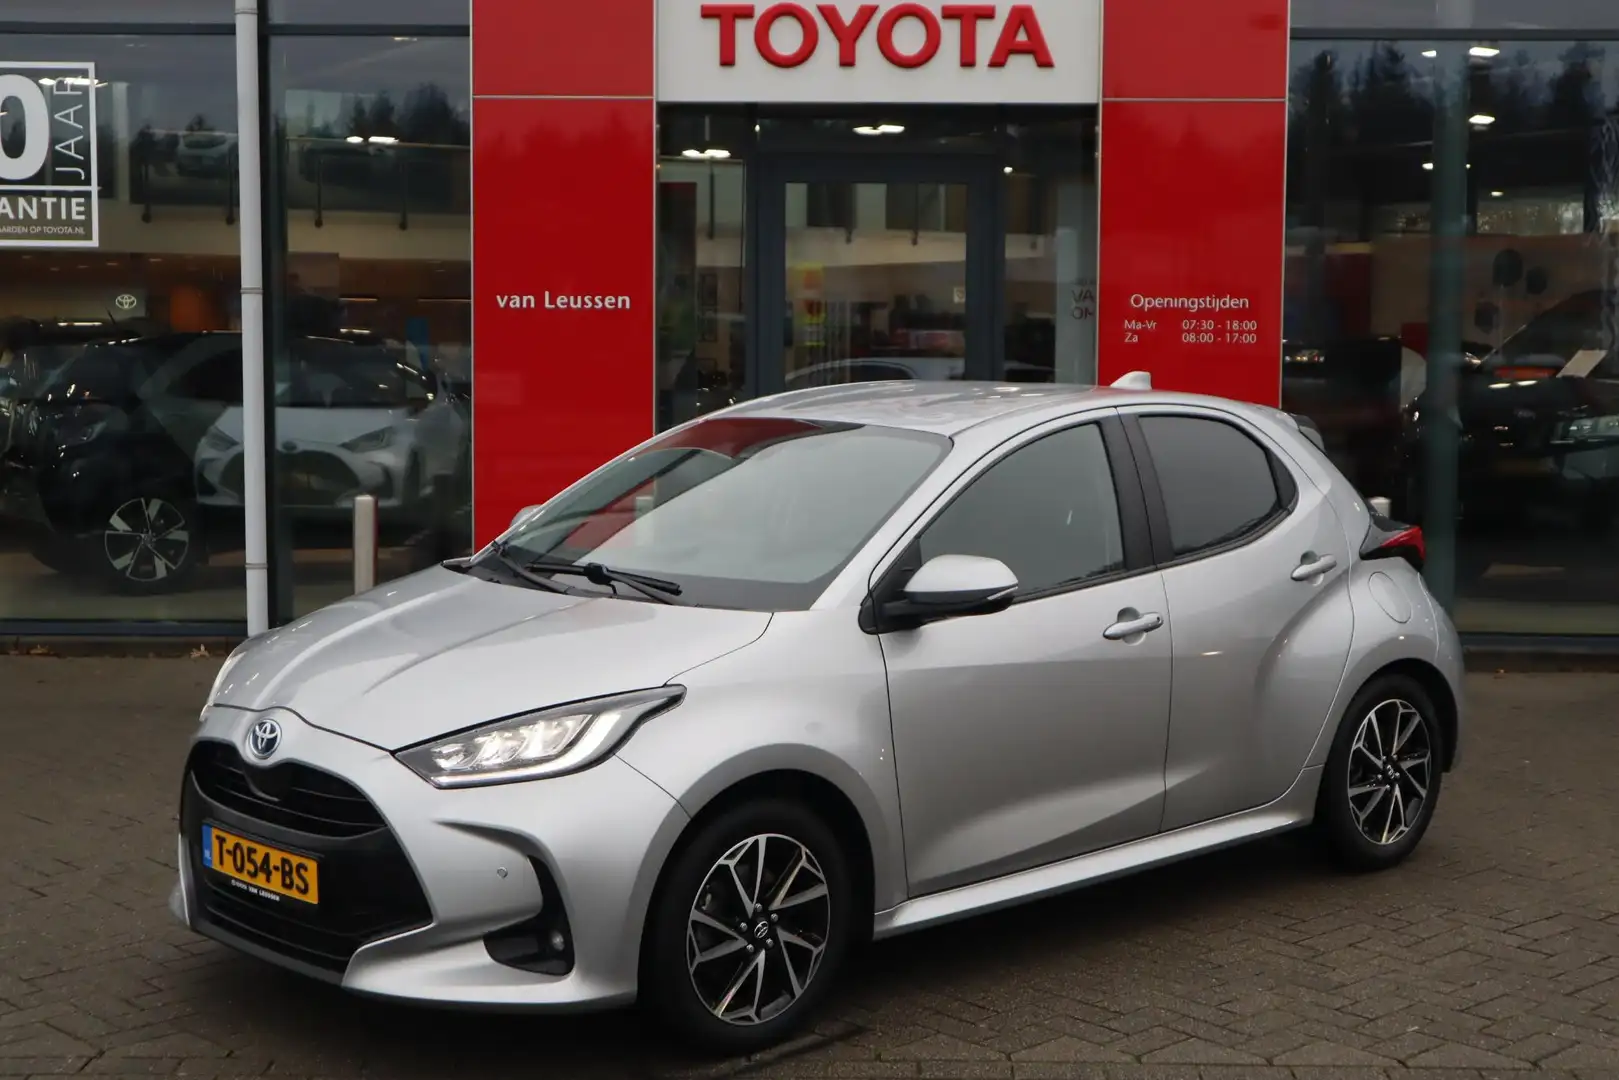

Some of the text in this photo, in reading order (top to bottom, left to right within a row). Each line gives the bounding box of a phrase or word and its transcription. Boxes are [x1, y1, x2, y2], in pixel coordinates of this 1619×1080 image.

[700, 2, 1055, 68] TOYOTA
[29, 226, 41, 235] OP
[43, 226, 86, 236] TOYOTA.NL
[496, 291, 631, 309] van Leussen
[1130, 293, 1249, 312] Openingstijden
[1124, 319, 1158, 331] Ma-Vr
[1182, 319, 1214, 331] 07:30
[1226, 319, 1257, 331] 18:00
[1124, 332, 1138, 343] Za
[1182, 332, 1214, 343] 08:00
[1226, 332, 1257, 344] 17:00
[215, 834, 309, 897] T-054-BS
